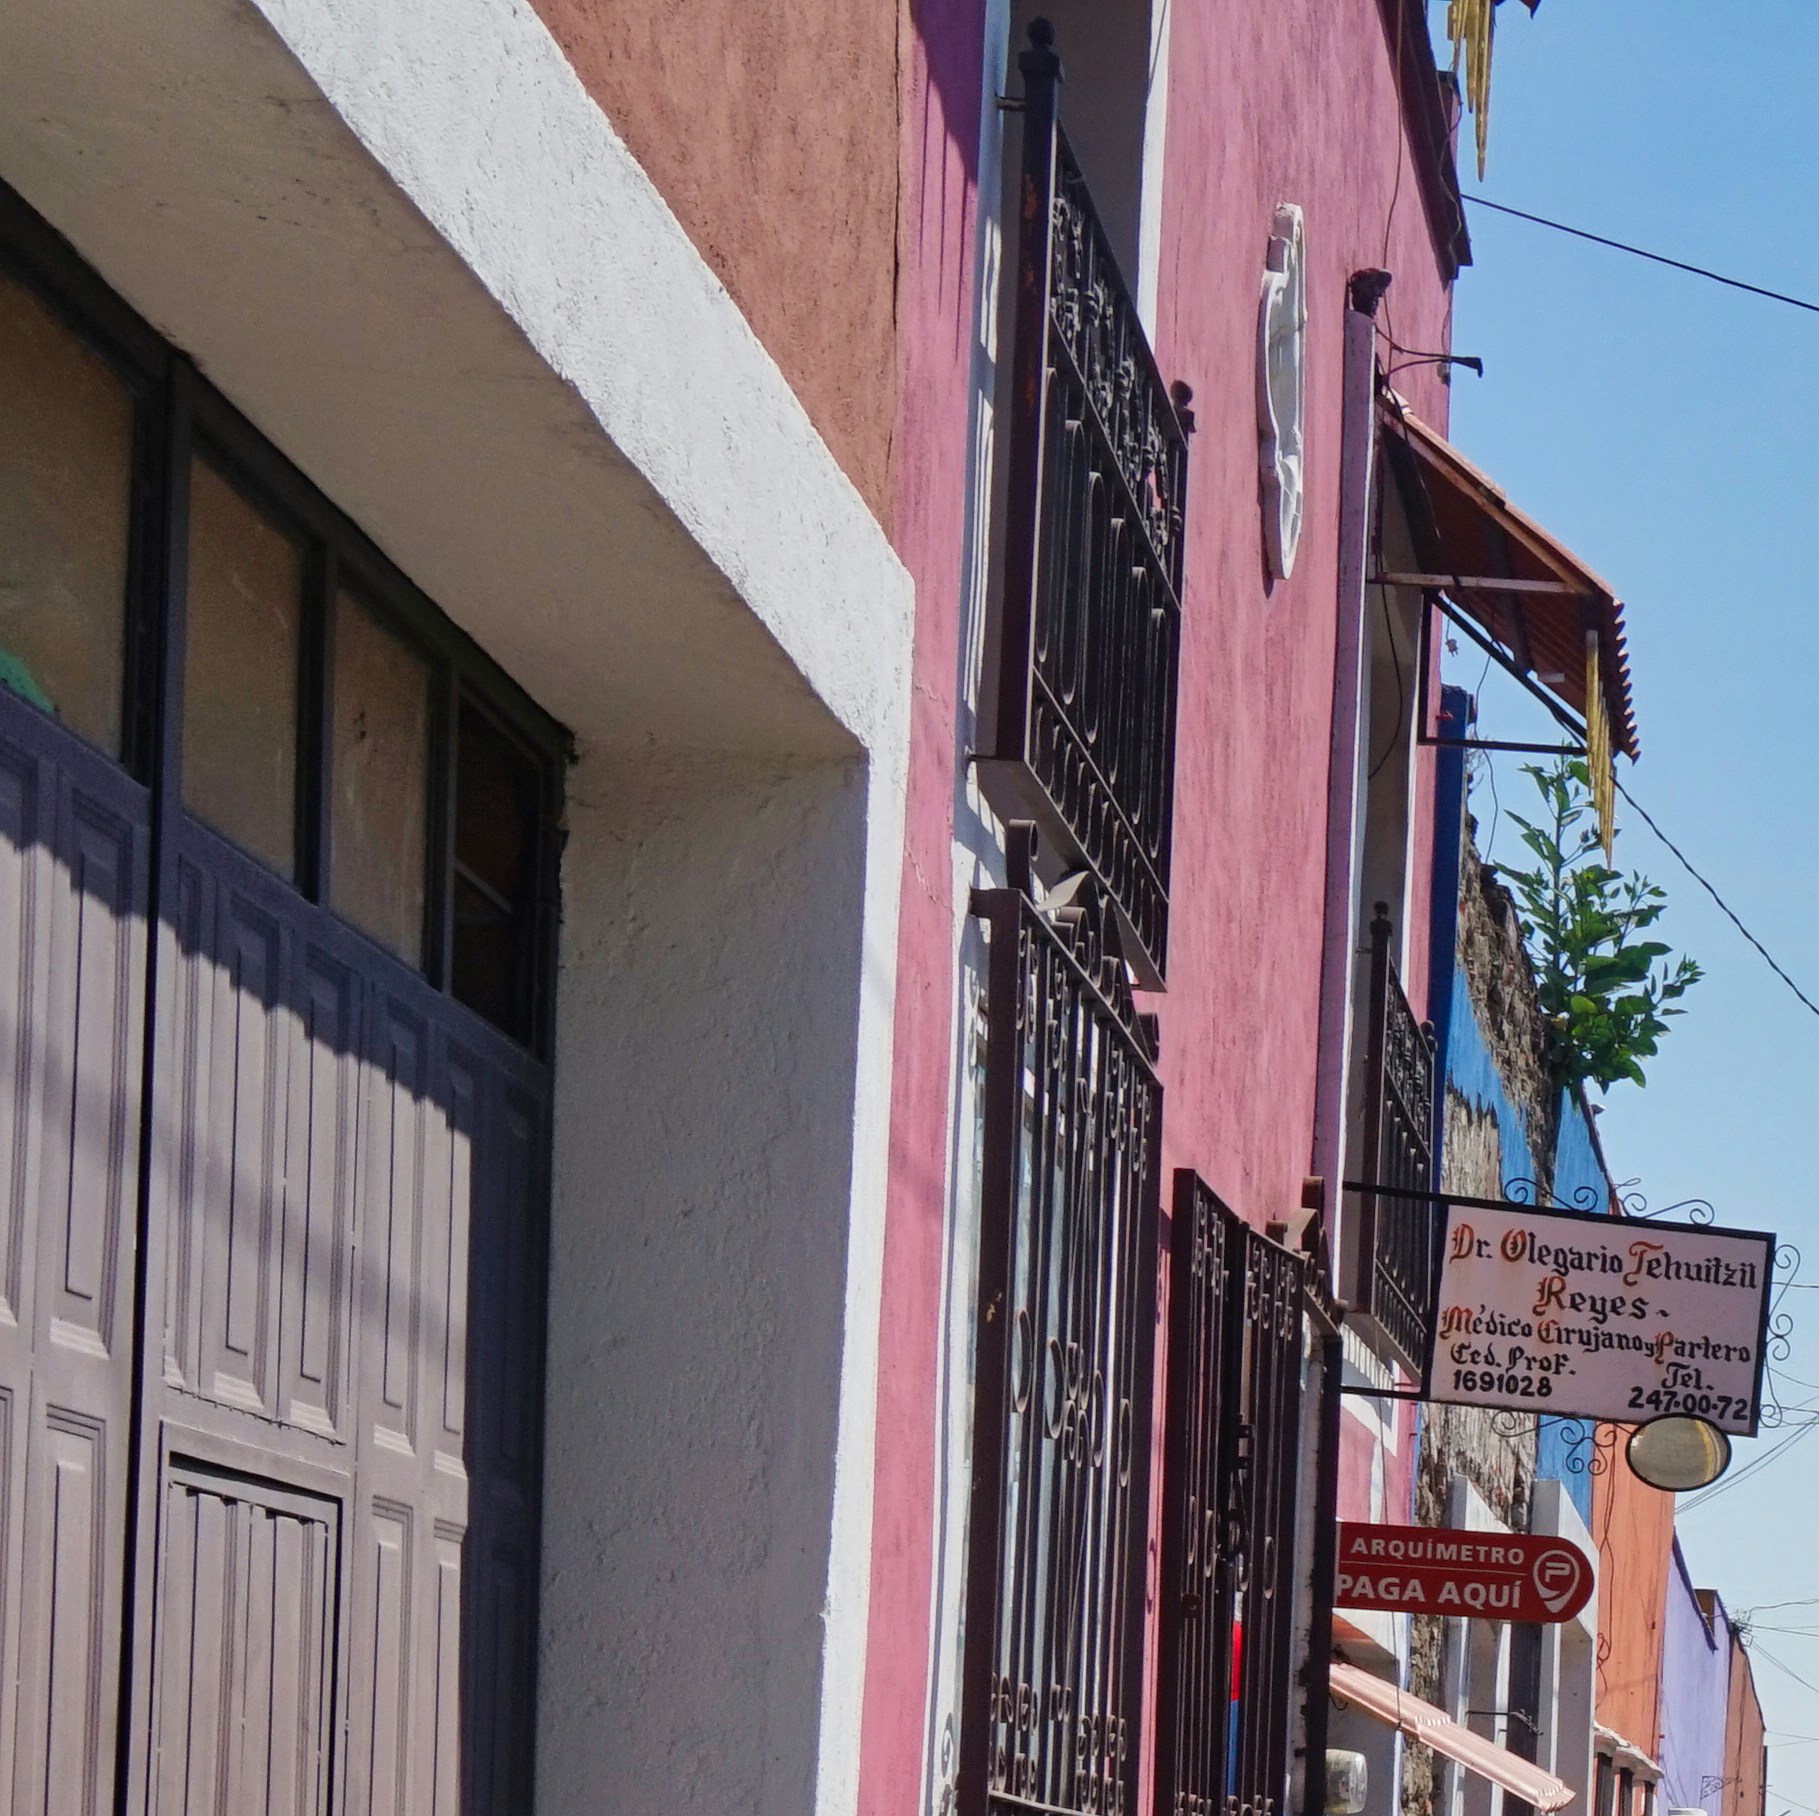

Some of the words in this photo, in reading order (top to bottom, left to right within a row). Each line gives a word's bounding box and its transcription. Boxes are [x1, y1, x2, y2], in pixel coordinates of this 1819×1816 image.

[1449, 1223, 1493, 1264] Dr.
[1500, 1228, 1623, 1277] Olegario
[1623, 1240, 1757, 1289] Tehuitzil
[1532, 1275, 1649, 1325] Reyes
[1439, 1303, 1532, 1340] Médico
[1537, 1319, 1643, 1353] Cirujano
[1644, 1341, 1655, 1357] y
[1654, 1331, 1751, 1364] Partero
[1450, 1341, 1502, 1368] Ced.
[1453, 1368, 1552, 1397] 1691028
[1661, 1361, 1714, 1391] Tel.
[1350, 1537, 1526, 1566] ARQUÍMETRO
[1335, 1573, 1426, 1603] PAGA
[1437, 1579, 1521, 1610] AQUÍ
